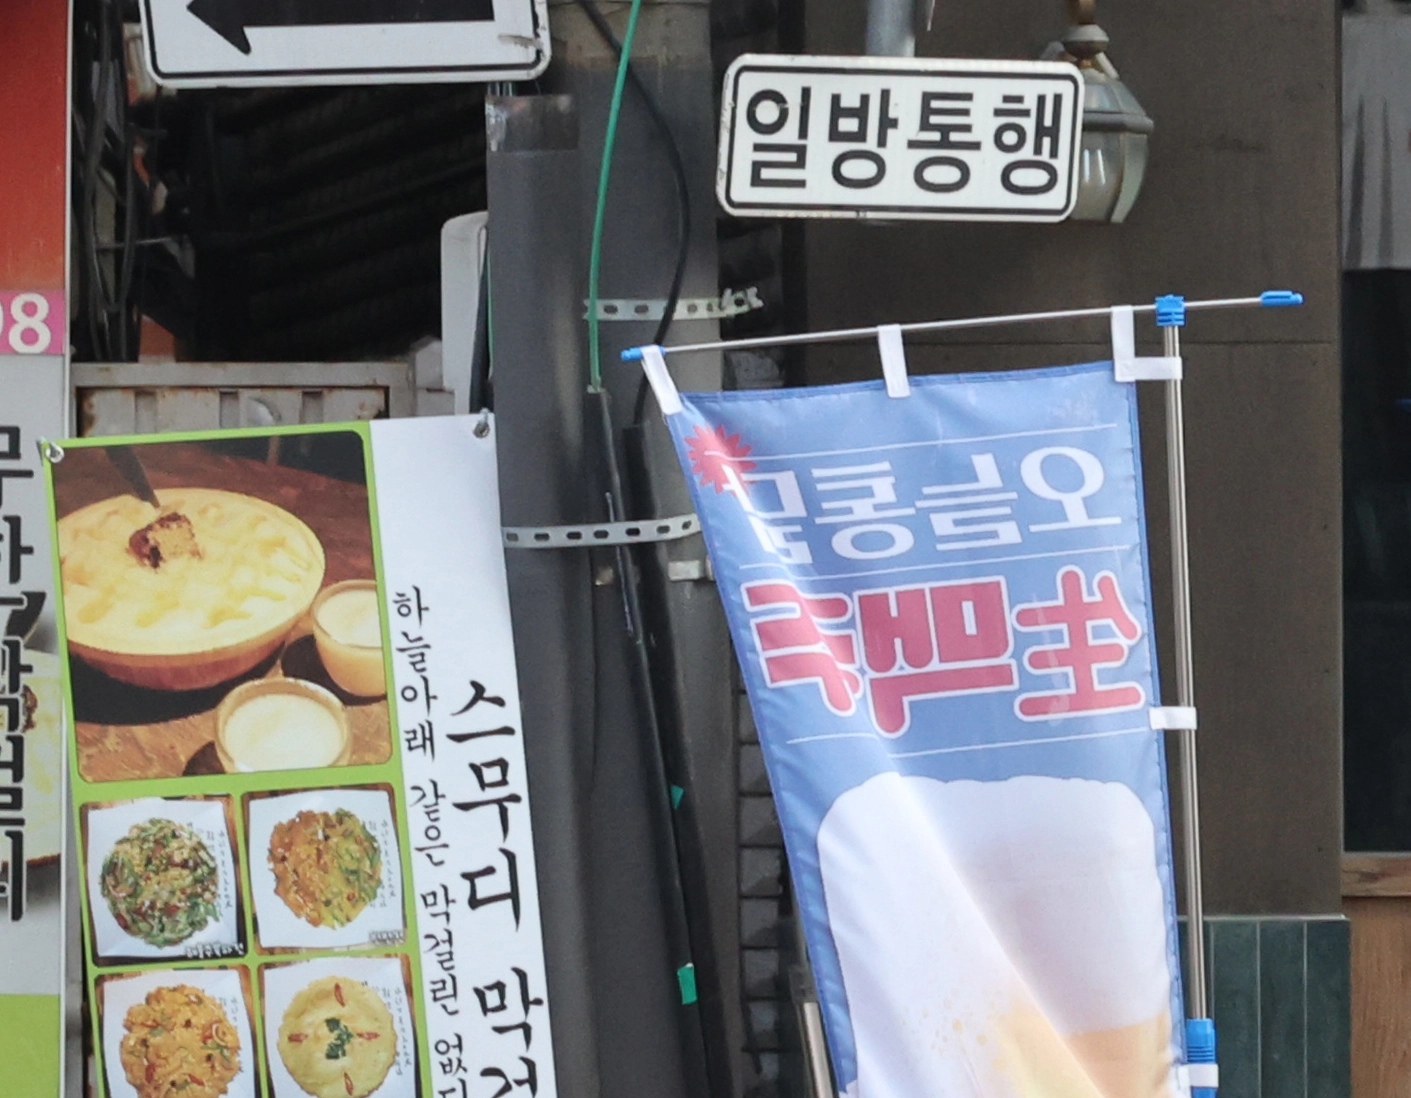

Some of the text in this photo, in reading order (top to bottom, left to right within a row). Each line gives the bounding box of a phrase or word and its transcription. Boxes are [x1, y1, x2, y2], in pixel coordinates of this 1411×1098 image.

[746, 86, 1064, 195] 일방통행
[408, 778, 451, 867] 같은
[446, 679, 524, 931] 스무디
